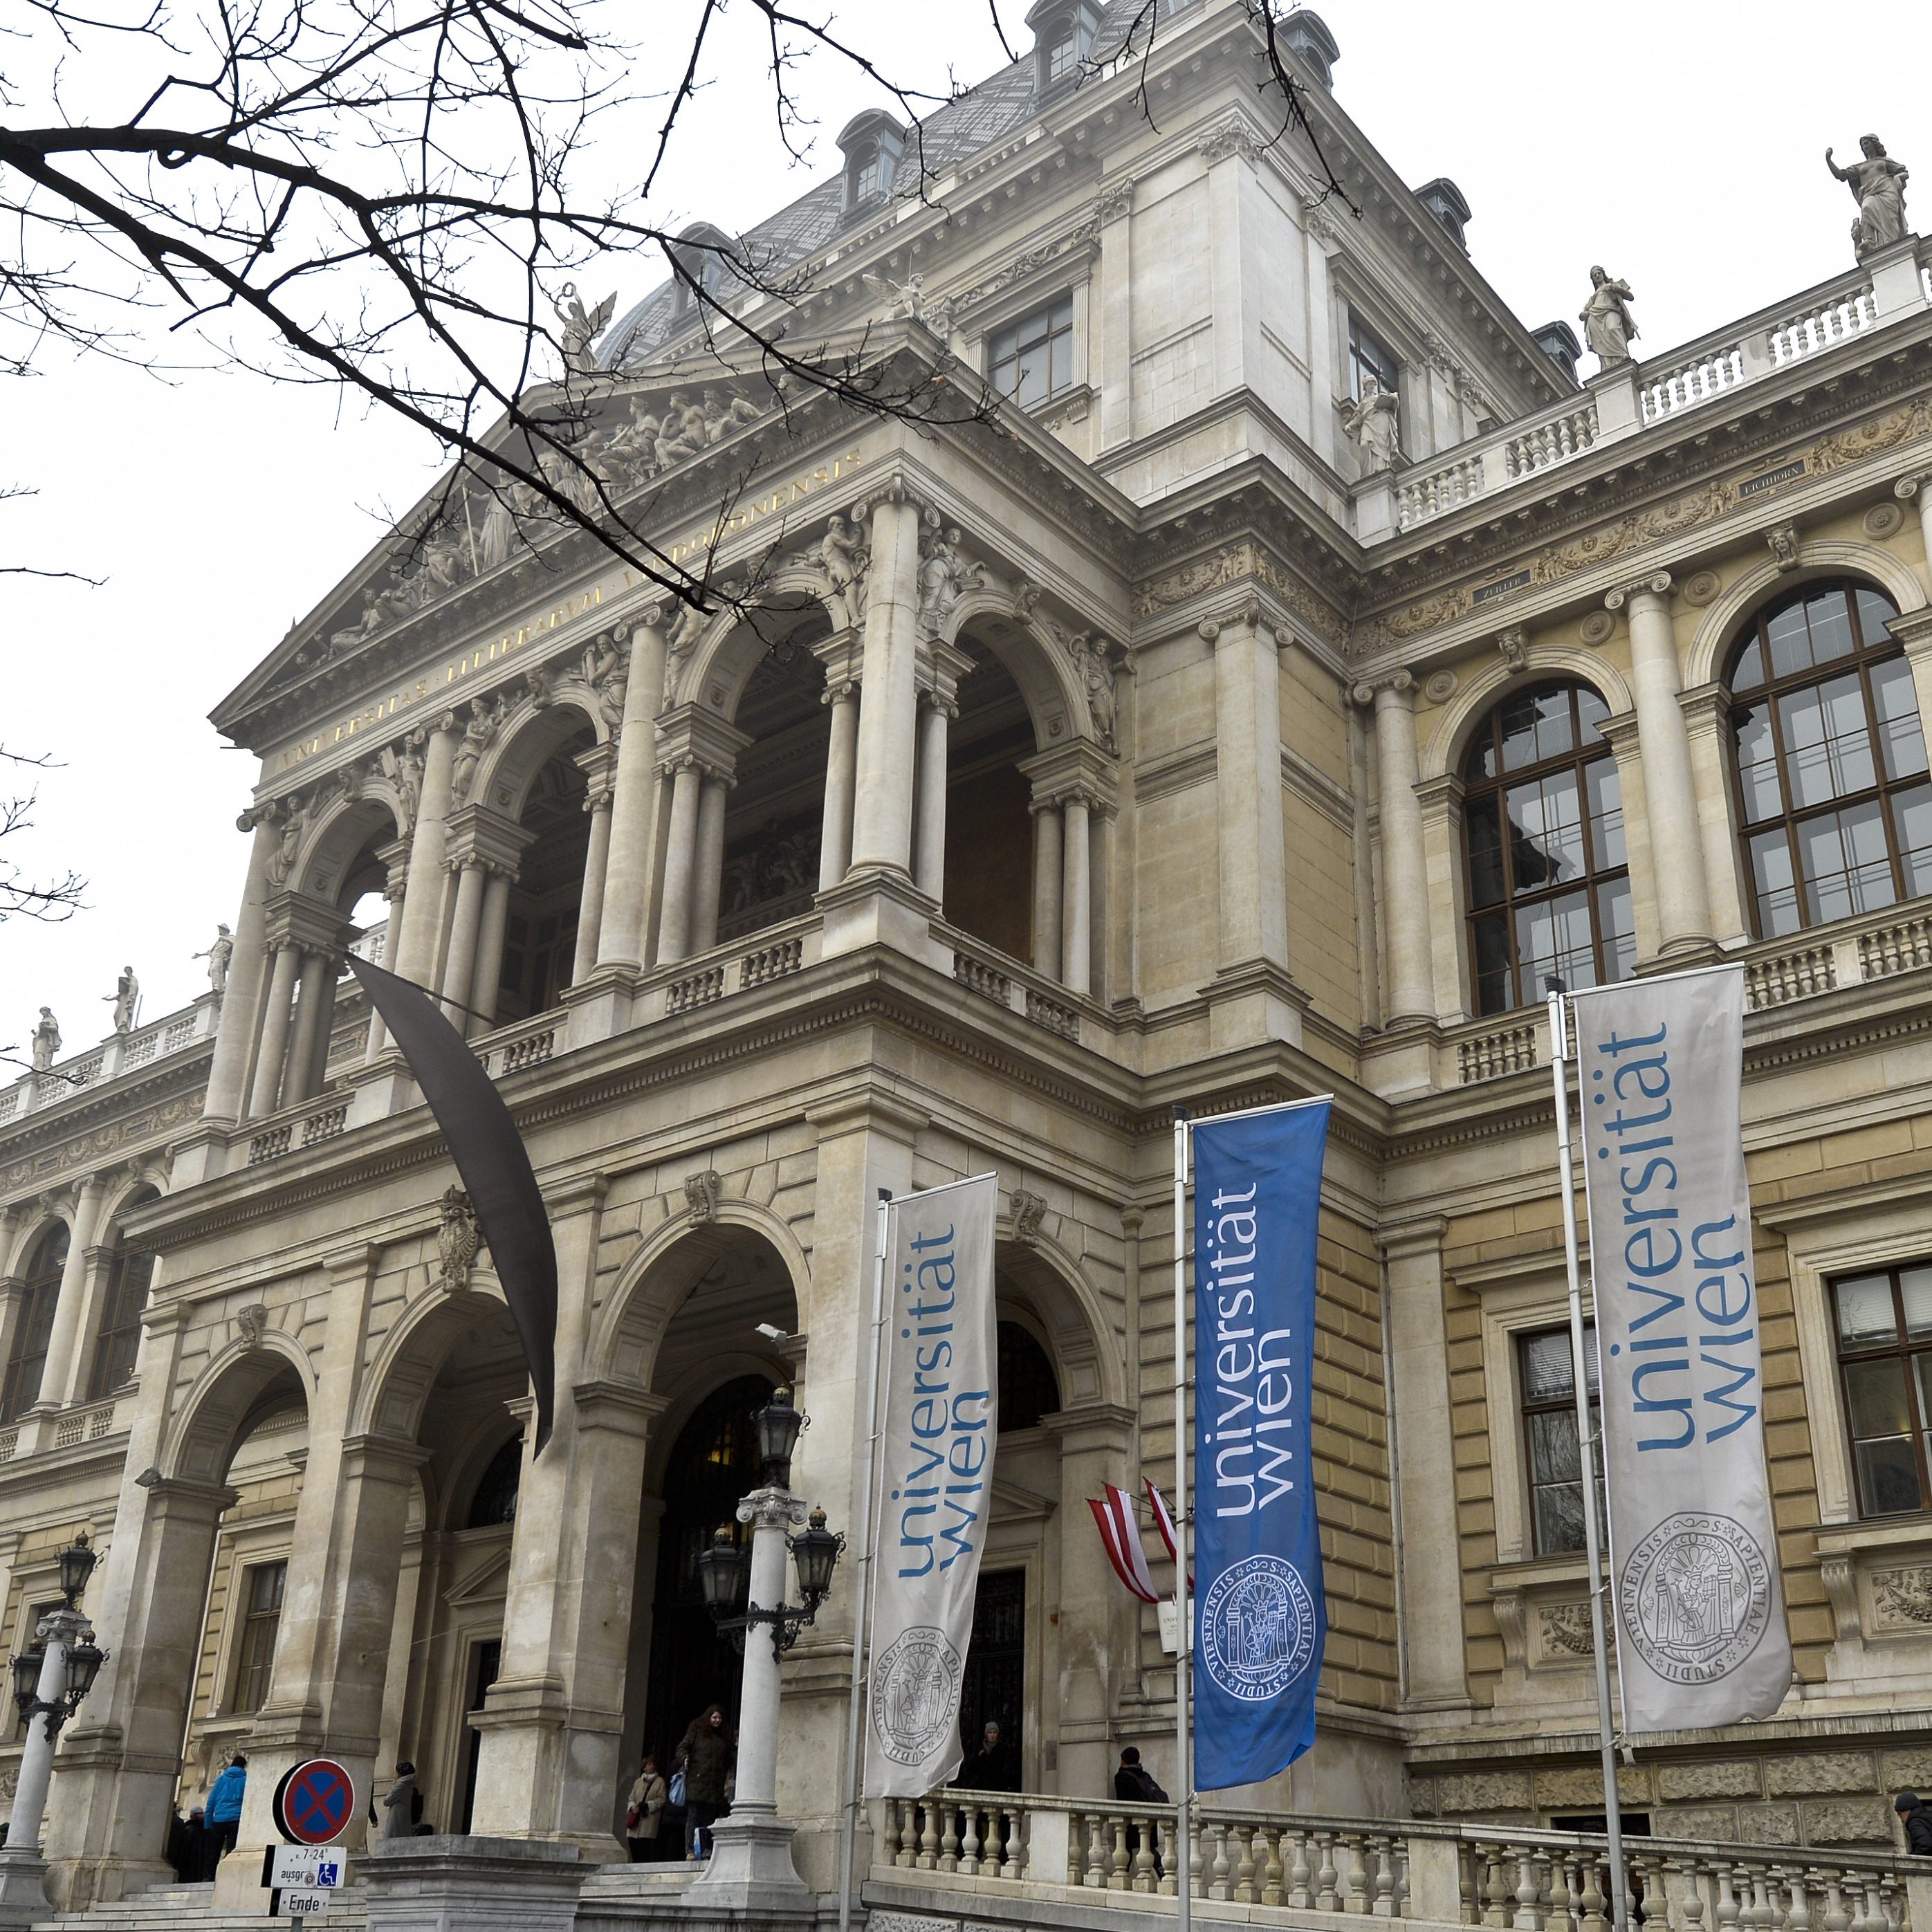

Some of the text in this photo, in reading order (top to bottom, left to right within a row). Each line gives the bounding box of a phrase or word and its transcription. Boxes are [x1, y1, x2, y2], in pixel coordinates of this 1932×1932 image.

[282, 679, 427, 766] UNIVERSITAS
[1594, 1022, 1695, 1452] universität
[1204, 1181, 1257, 1518] universität
[1691, 1213, 1757, 1444] wien
[891, 1223, 955, 1579] universität
[1255, 1328, 1294, 1511] wien
[939, 1388, 990, 1572] wien
[1205, 1574, 1235, 1672] VIENNENSIS
[1285, 1571, 1312, 1662] SAPIENTIAE
[1623, 1534, 1662, 1650] VIENNENSIS
[1729, 1528, 1766, 1635] SAPIENTIAE
[1234, 1680, 1280, 1697] STUDII
[1665, 1658, 1726, 1680] STUDII
[888, 1745, 926, 1763] SUDII
[289, 1894, 320, 1911] Ende
